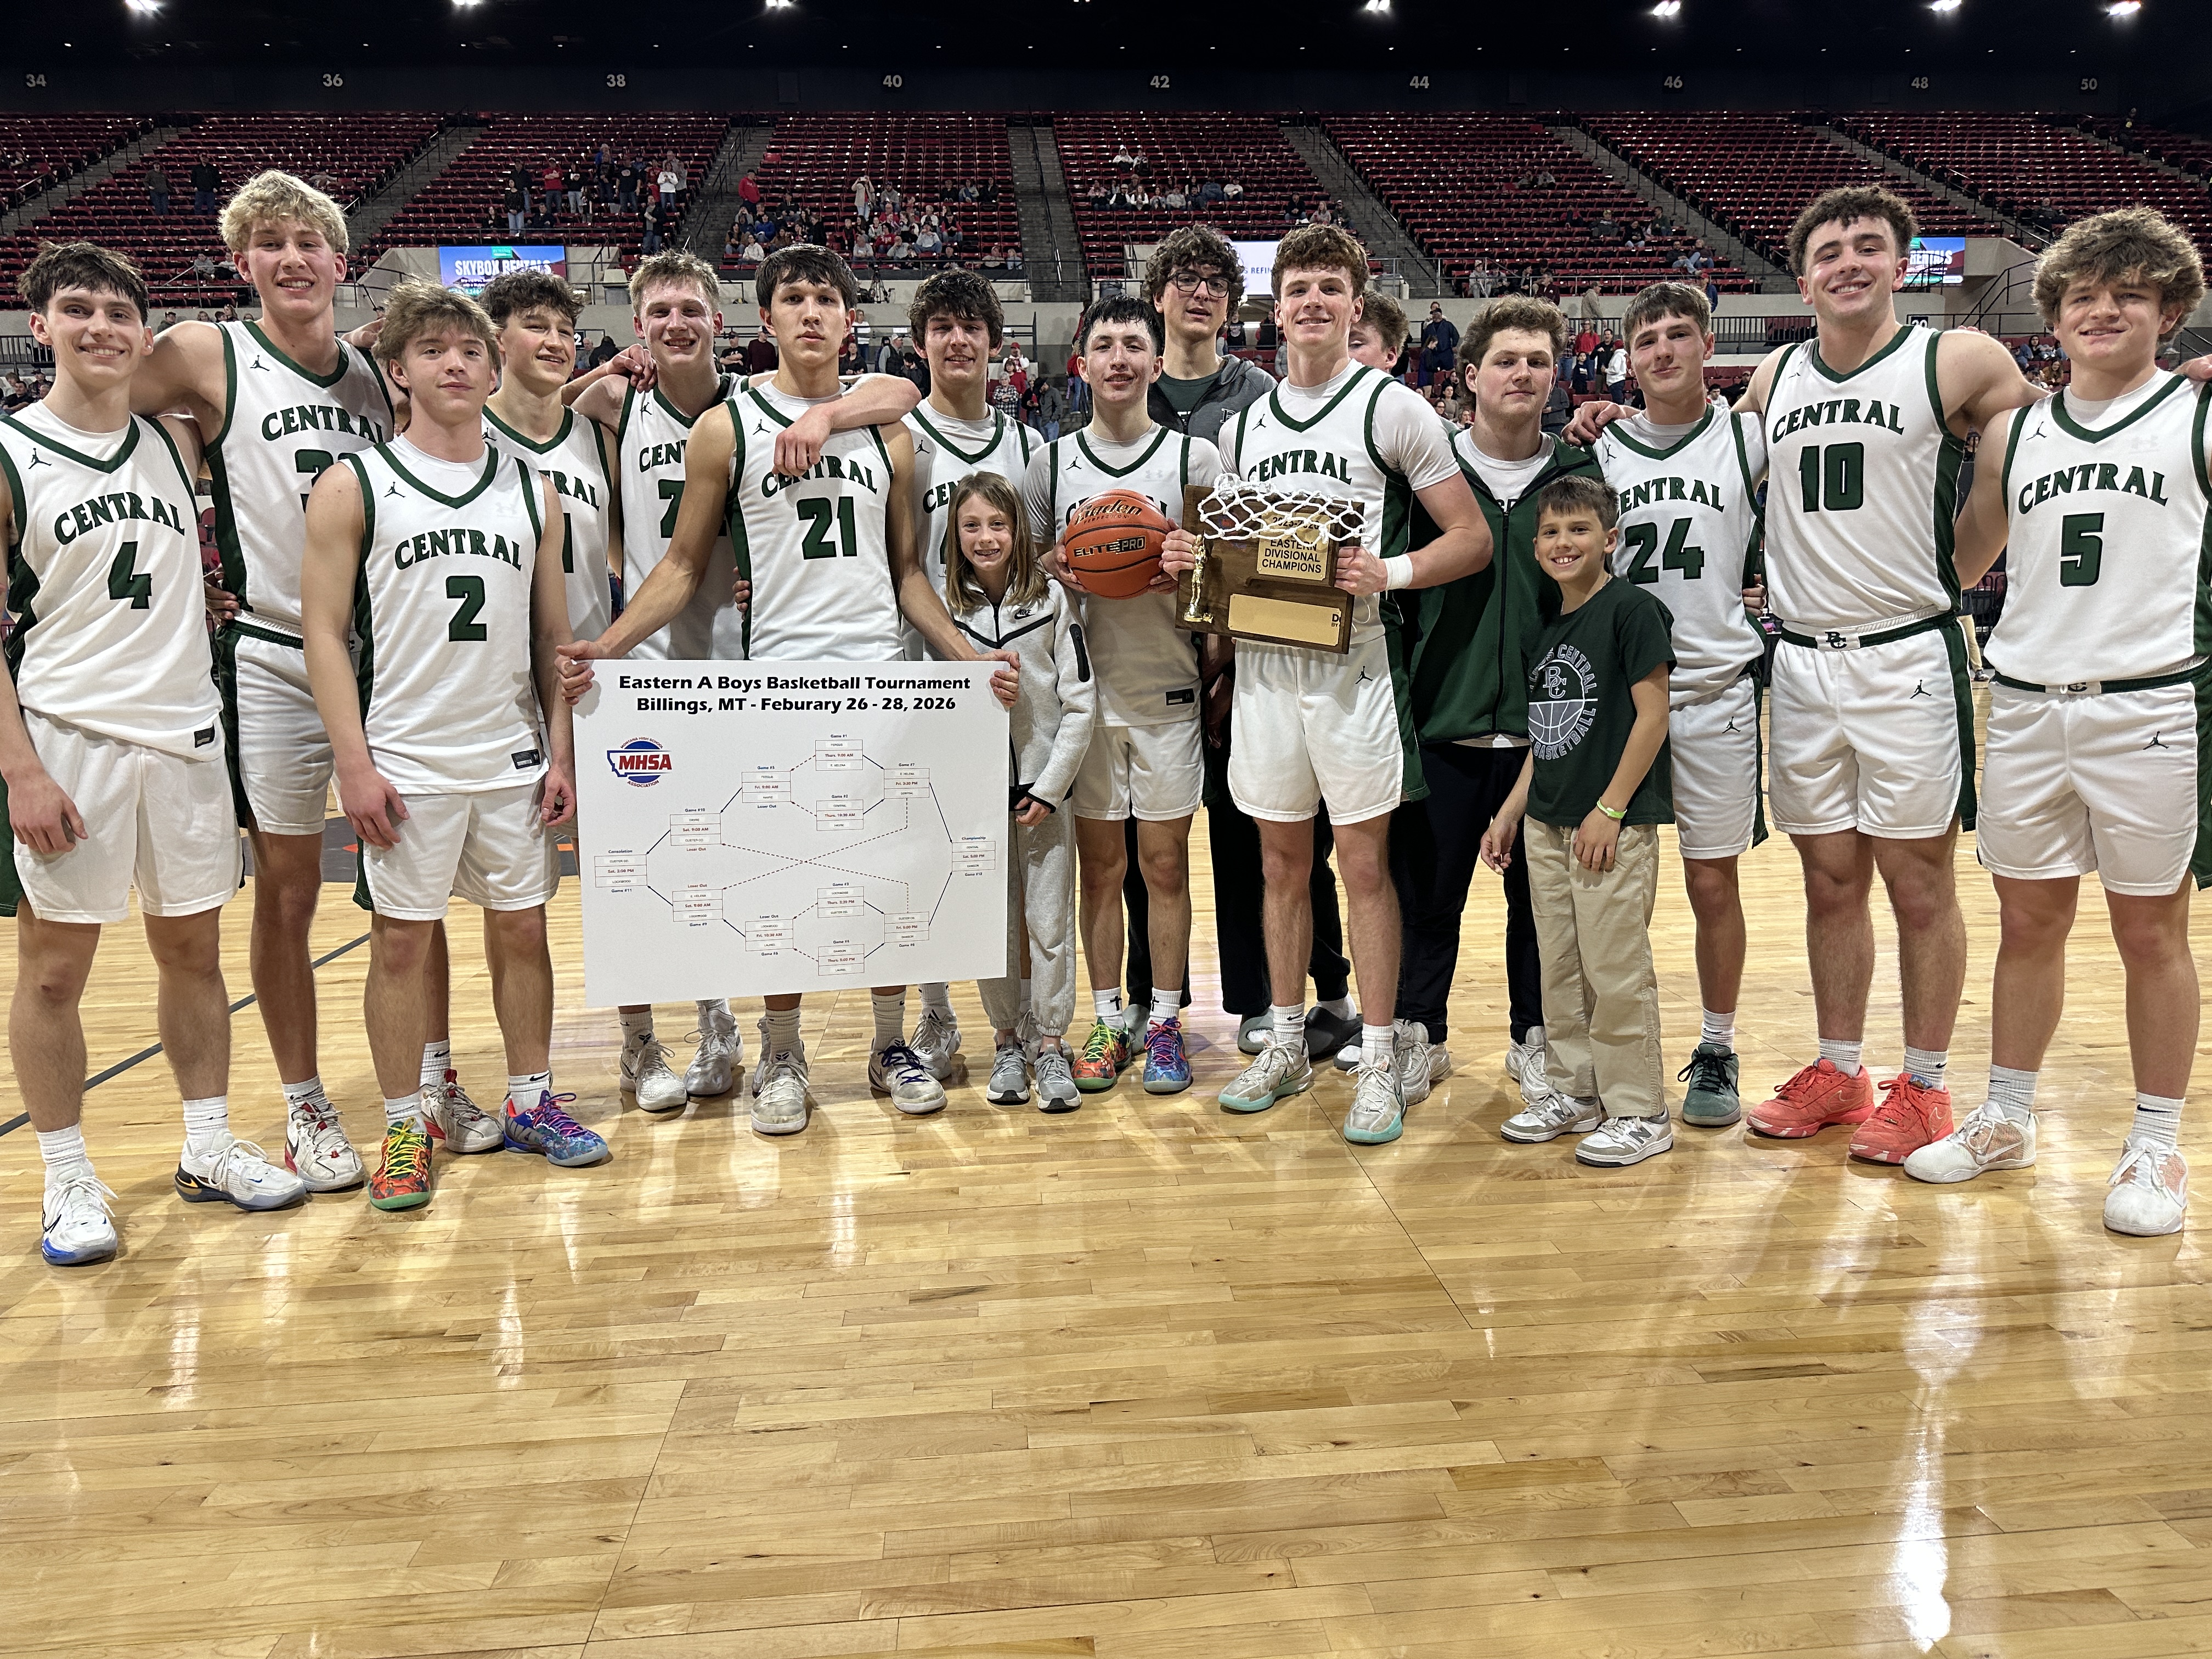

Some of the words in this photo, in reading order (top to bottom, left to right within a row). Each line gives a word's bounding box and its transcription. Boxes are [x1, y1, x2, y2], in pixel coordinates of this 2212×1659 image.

[26, 74, 47, 87] 34
[323, 74, 343, 87] 36
[607, 74, 626, 87] 38
[883, 75, 902, 87] 40
[1150, 76, 1170, 88] 42
[1409, 76, 1429, 89] 44
[1664, 76, 1683, 88] 46
[1911, 77, 1928, 89] 48
[2081, 78, 2098, 90] 50
[455, 259, 500, 276] SKYBOX
[1772, 399, 1905, 444] CENTRAL
[1798, 442, 1864, 513] 10
[1619, 477, 1725, 516] ENTRAL
[2018, 462, 2169, 515] CENTRAL
[54, 492, 185, 545] CENTRAL
[796, 496, 857, 560] 21
[394, 528, 522, 572] CENTRAL
[1073, 541, 1120, 557] ELITE
[1121, 537, 1144, 551] PRO
[1265, 548, 1321, 562] DIVISIONAL
[1624, 517, 1705, 585] 24
[2059, 512, 2105, 588] 5
[1262, 558, 1322, 573] CHAMPIONS
[108, 541, 152, 610] 4
[446, 575, 487, 642] 2
[1557, 644, 1597, 694] CENTRAL
[619, 675, 692, 689] Eastern
[697, 676, 713, 689] A
[718, 676, 761, 693] Boys
[767, 676, 860, 689] Basketball
[865, 676, 970, 689] Tournament
[637, 697, 713, 714] Billings,
[718, 698, 747, 710] MT
[761, 697, 842, 714] Feburary
[846, 697, 868, 710] 26
[882, 697, 909, 712] 28,
[913, 697, 956, 710] 2026
[1533, 708, 1596, 760] BASKETBALL
[620, 737, 639, 749] MONTANA
[650, 738, 663, 749] SCHOOL
[619, 754, 672, 770] MHSA
[627, 780, 659, 788] ASSOCIATION
